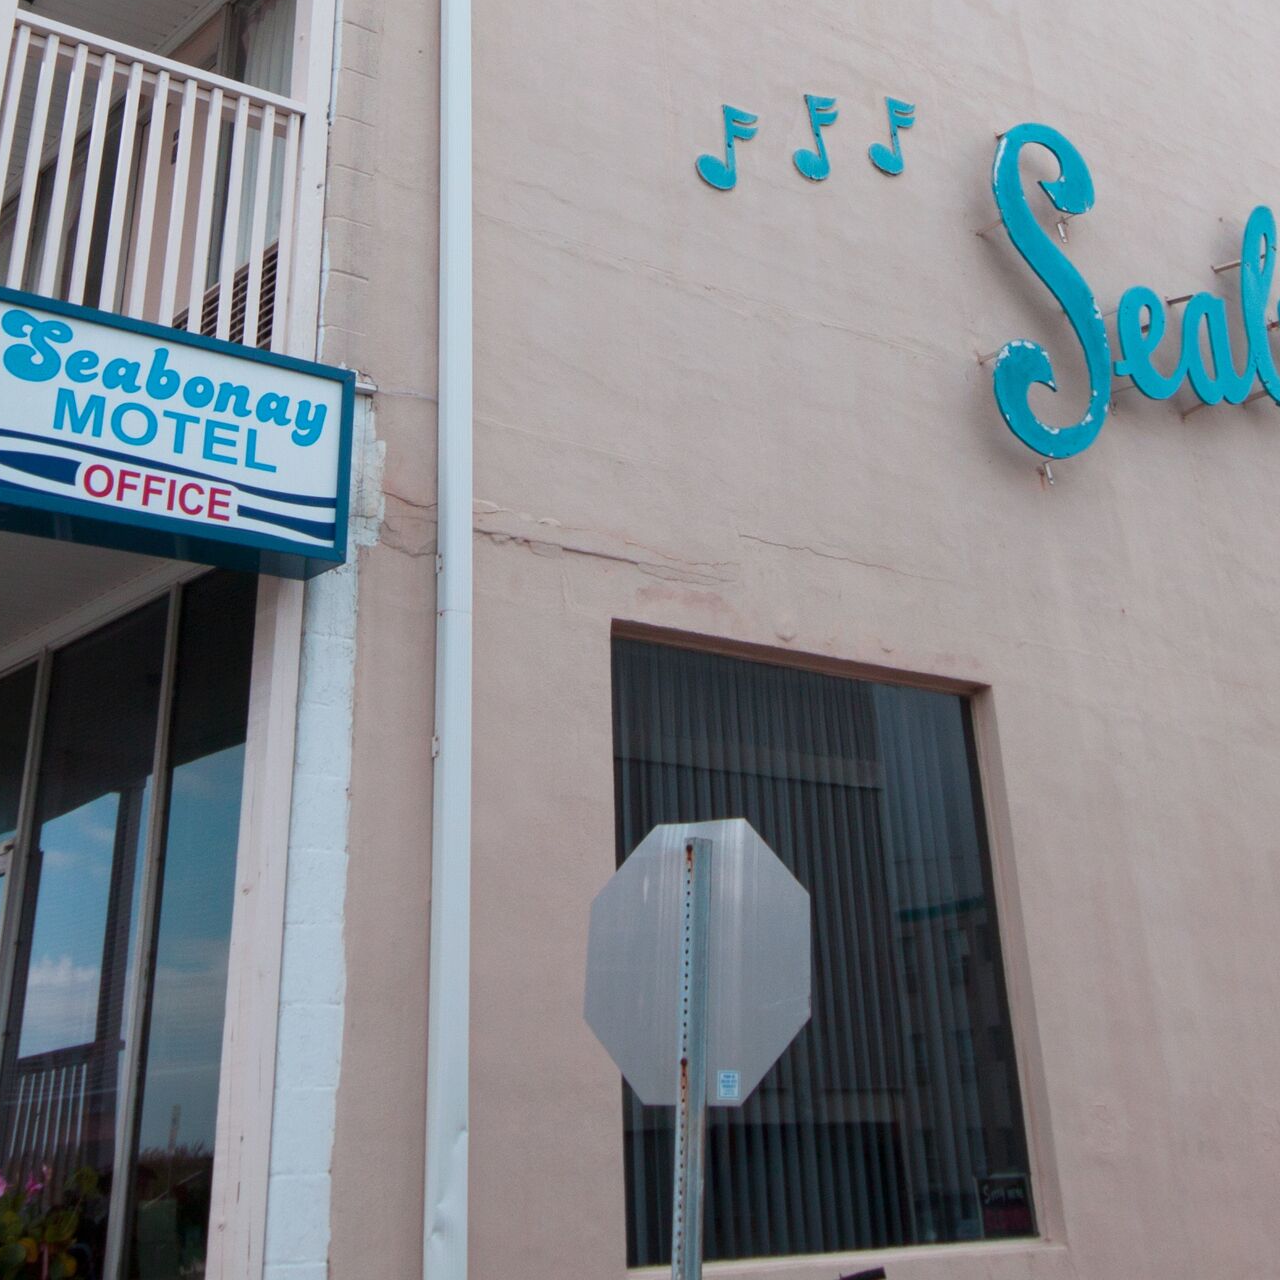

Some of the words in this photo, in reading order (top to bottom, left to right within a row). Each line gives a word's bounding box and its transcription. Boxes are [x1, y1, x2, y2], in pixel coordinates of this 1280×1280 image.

[1, 309, 328, 448] Seabonay
[53, 387, 277, 474] MOTEL
[82, 463, 231, 521] OFFICE
